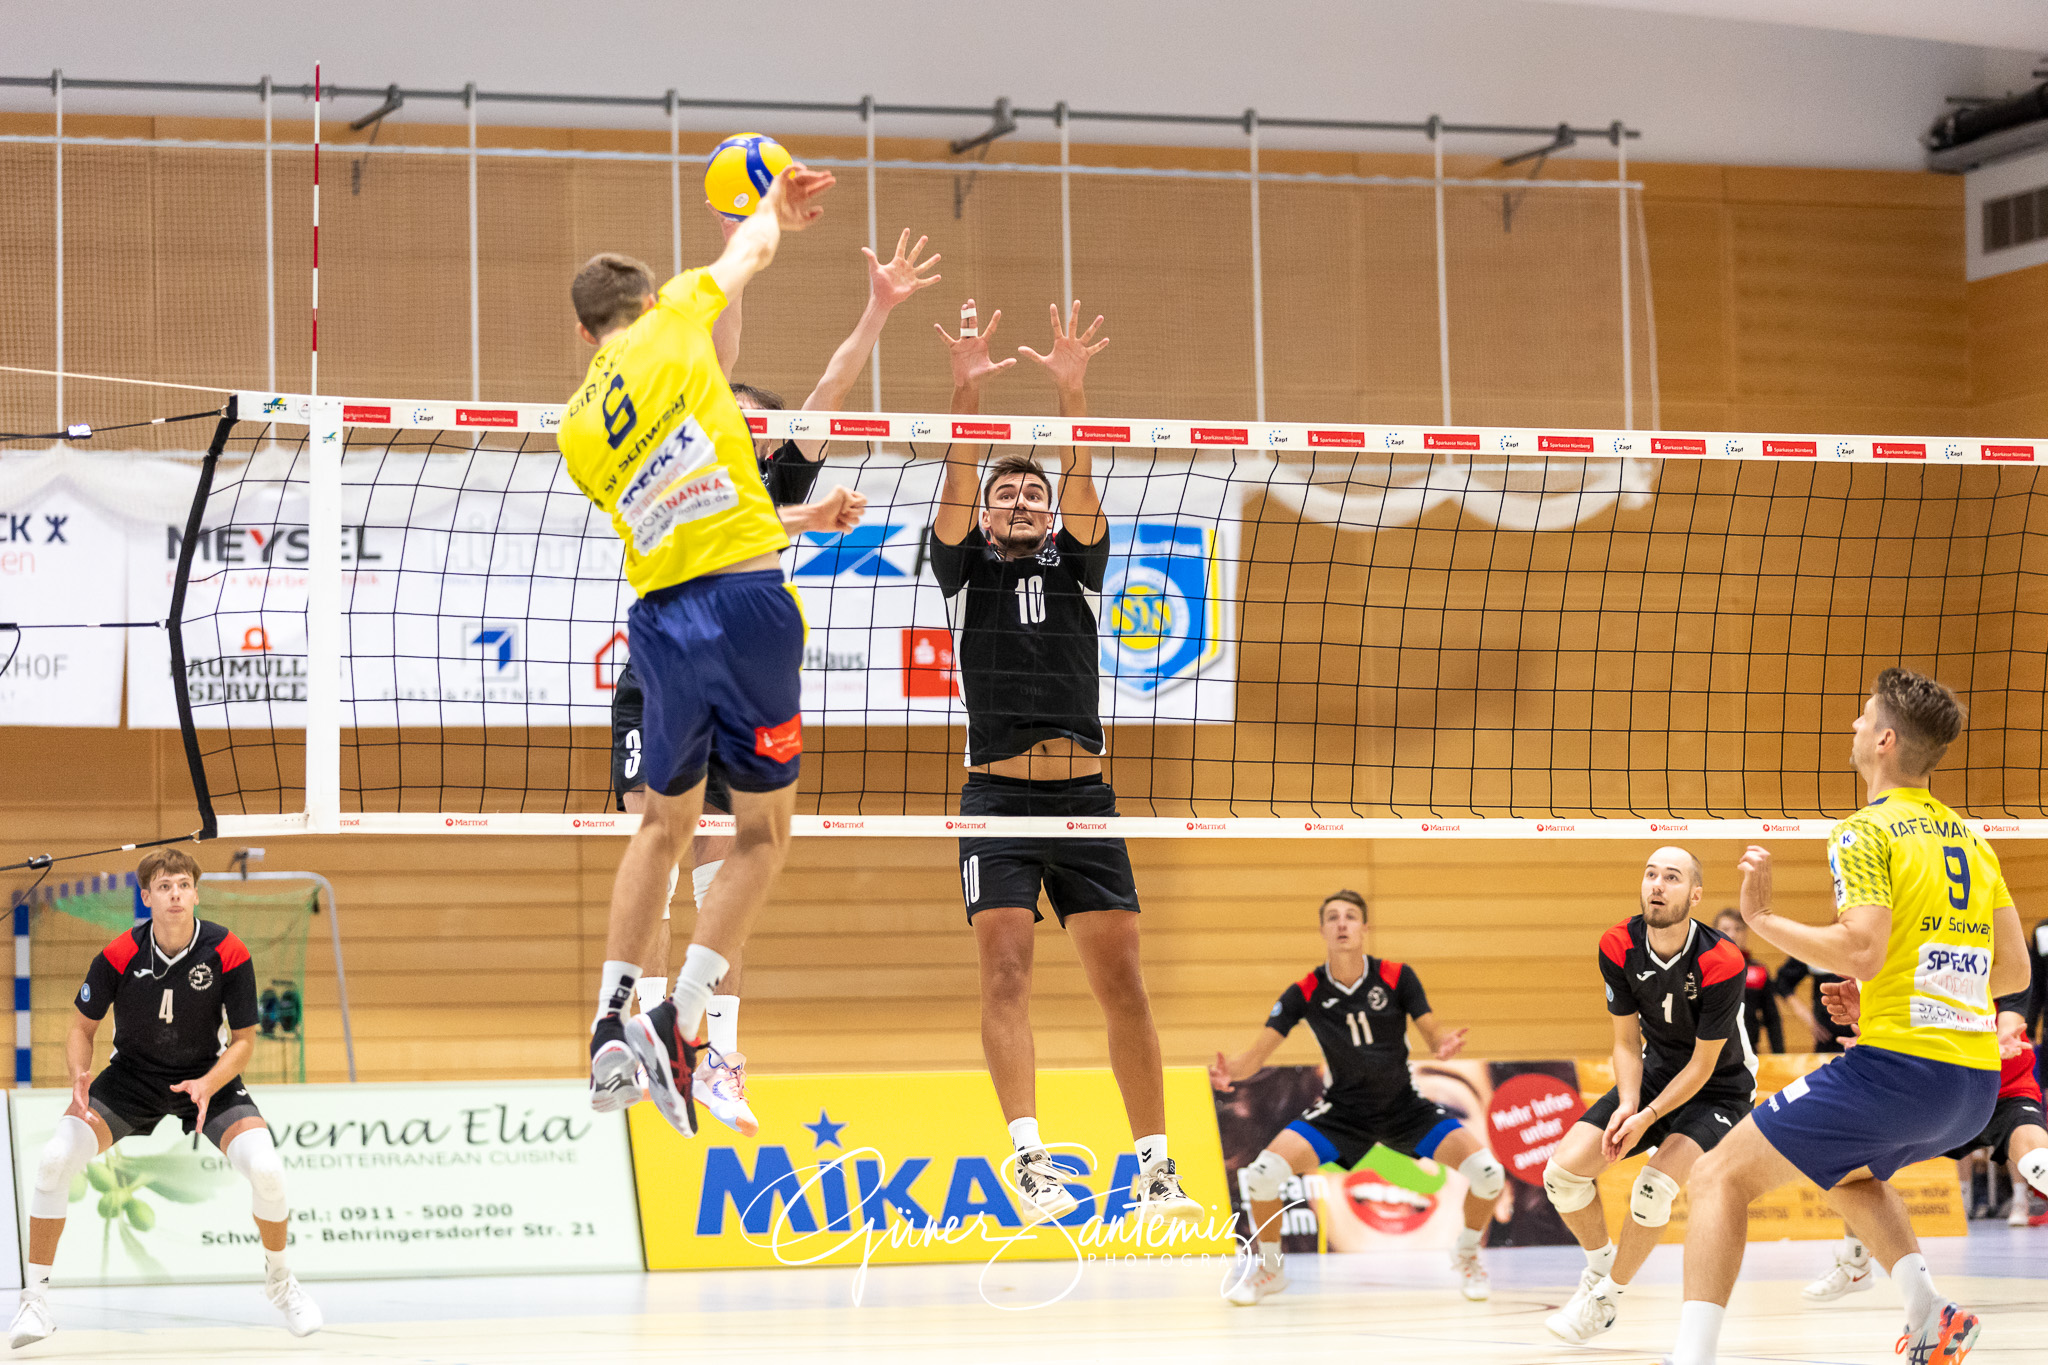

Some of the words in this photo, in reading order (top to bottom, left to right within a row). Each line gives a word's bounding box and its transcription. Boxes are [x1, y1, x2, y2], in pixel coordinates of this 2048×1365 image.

[602, 373, 637, 450] 6
[1014, 575, 1046, 624] 10
[624, 728, 642, 779] 3
[455, 819, 488, 827] Marmot
[582, 820, 615, 828] Marmot
[832, 821, 864, 829] Marmot
[1075, 822, 1107, 830] Marmot
[1313, 823, 1344, 831] Marmot
[1430, 824, 1460, 832] Marmot
[1545, 824, 1575, 832] Marmot
[1992, 824, 2020, 832] Marmot
[963, 854, 980, 907] 10
[1943, 846, 1971, 911] 9
[1920, 916, 1942, 931] SV
[158, 988, 174, 1024] 4
[1661, 992, 1673, 1024] 1
[1346, 1010, 1374, 1047] 11
[190, 1117, 451, 1151] verna
[461, 1103, 592, 1146] Elia
[283, 1152, 482, 1170] MEDITERRANEAN
[489, 1149, 578, 1166] CUISINE
[340, 1206, 395, 1221] 0911
[422, 1204, 463, 1219] 500
[473, 1203, 513, 1218] 200
[321, 1223, 514, 1243] Behringersdorfer
[524, 1223, 563, 1237] Str.
[572, 1221, 596, 1236] 21
